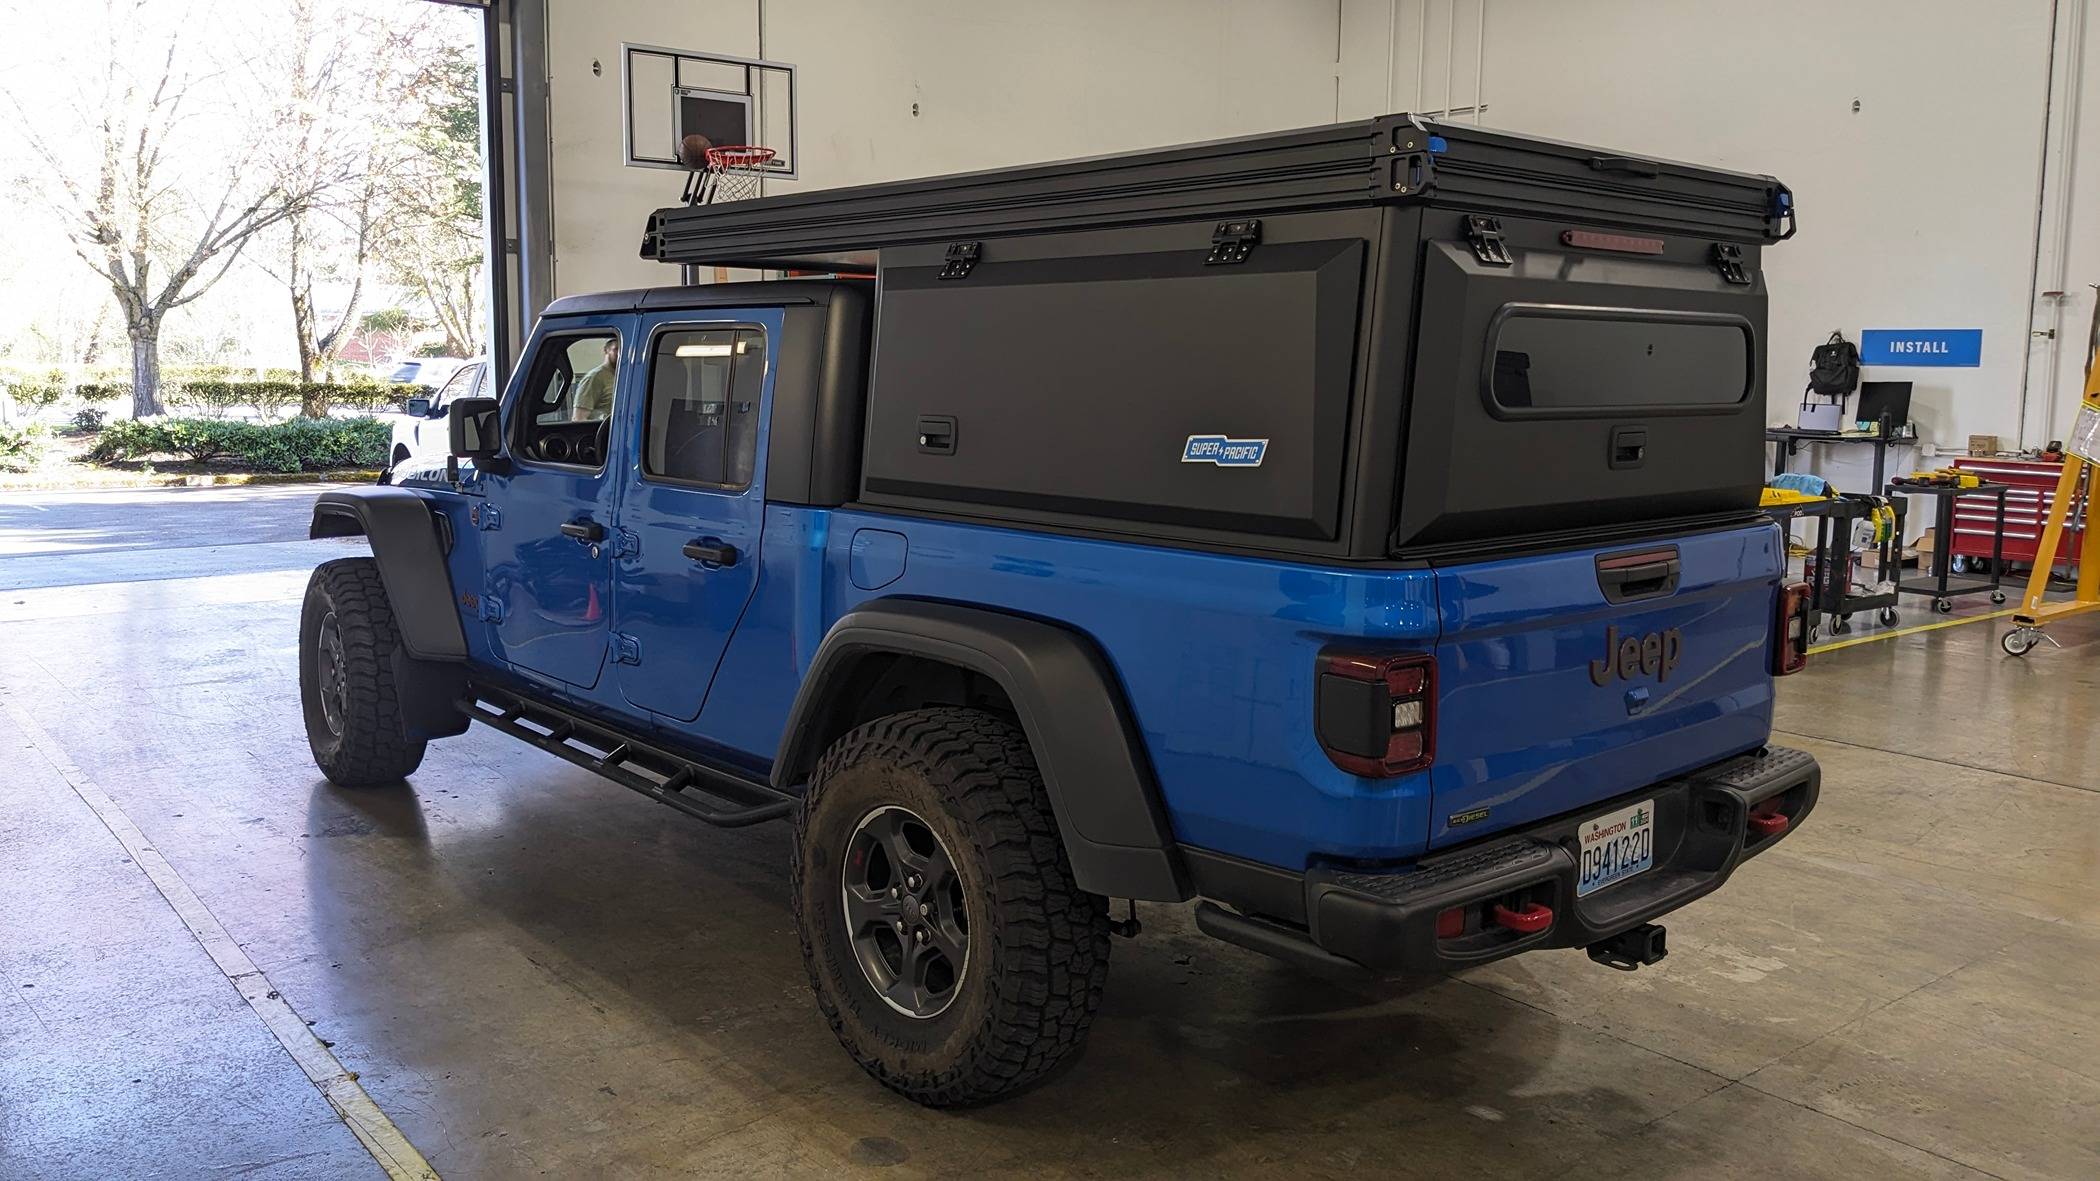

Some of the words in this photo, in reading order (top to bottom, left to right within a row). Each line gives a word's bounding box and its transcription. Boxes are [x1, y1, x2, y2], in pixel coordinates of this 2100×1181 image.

[1890, 341, 1948, 353] INSTALL
[1190, 442, 1220, 455] SUPER
[1223, 446, 1259, 459] PACIFIC
[1588, 625, 1682, 687] Jeep
[1584, 821, 1627, 844] WASHINGTON
[1583, 827, 1650, 885] D94122D
